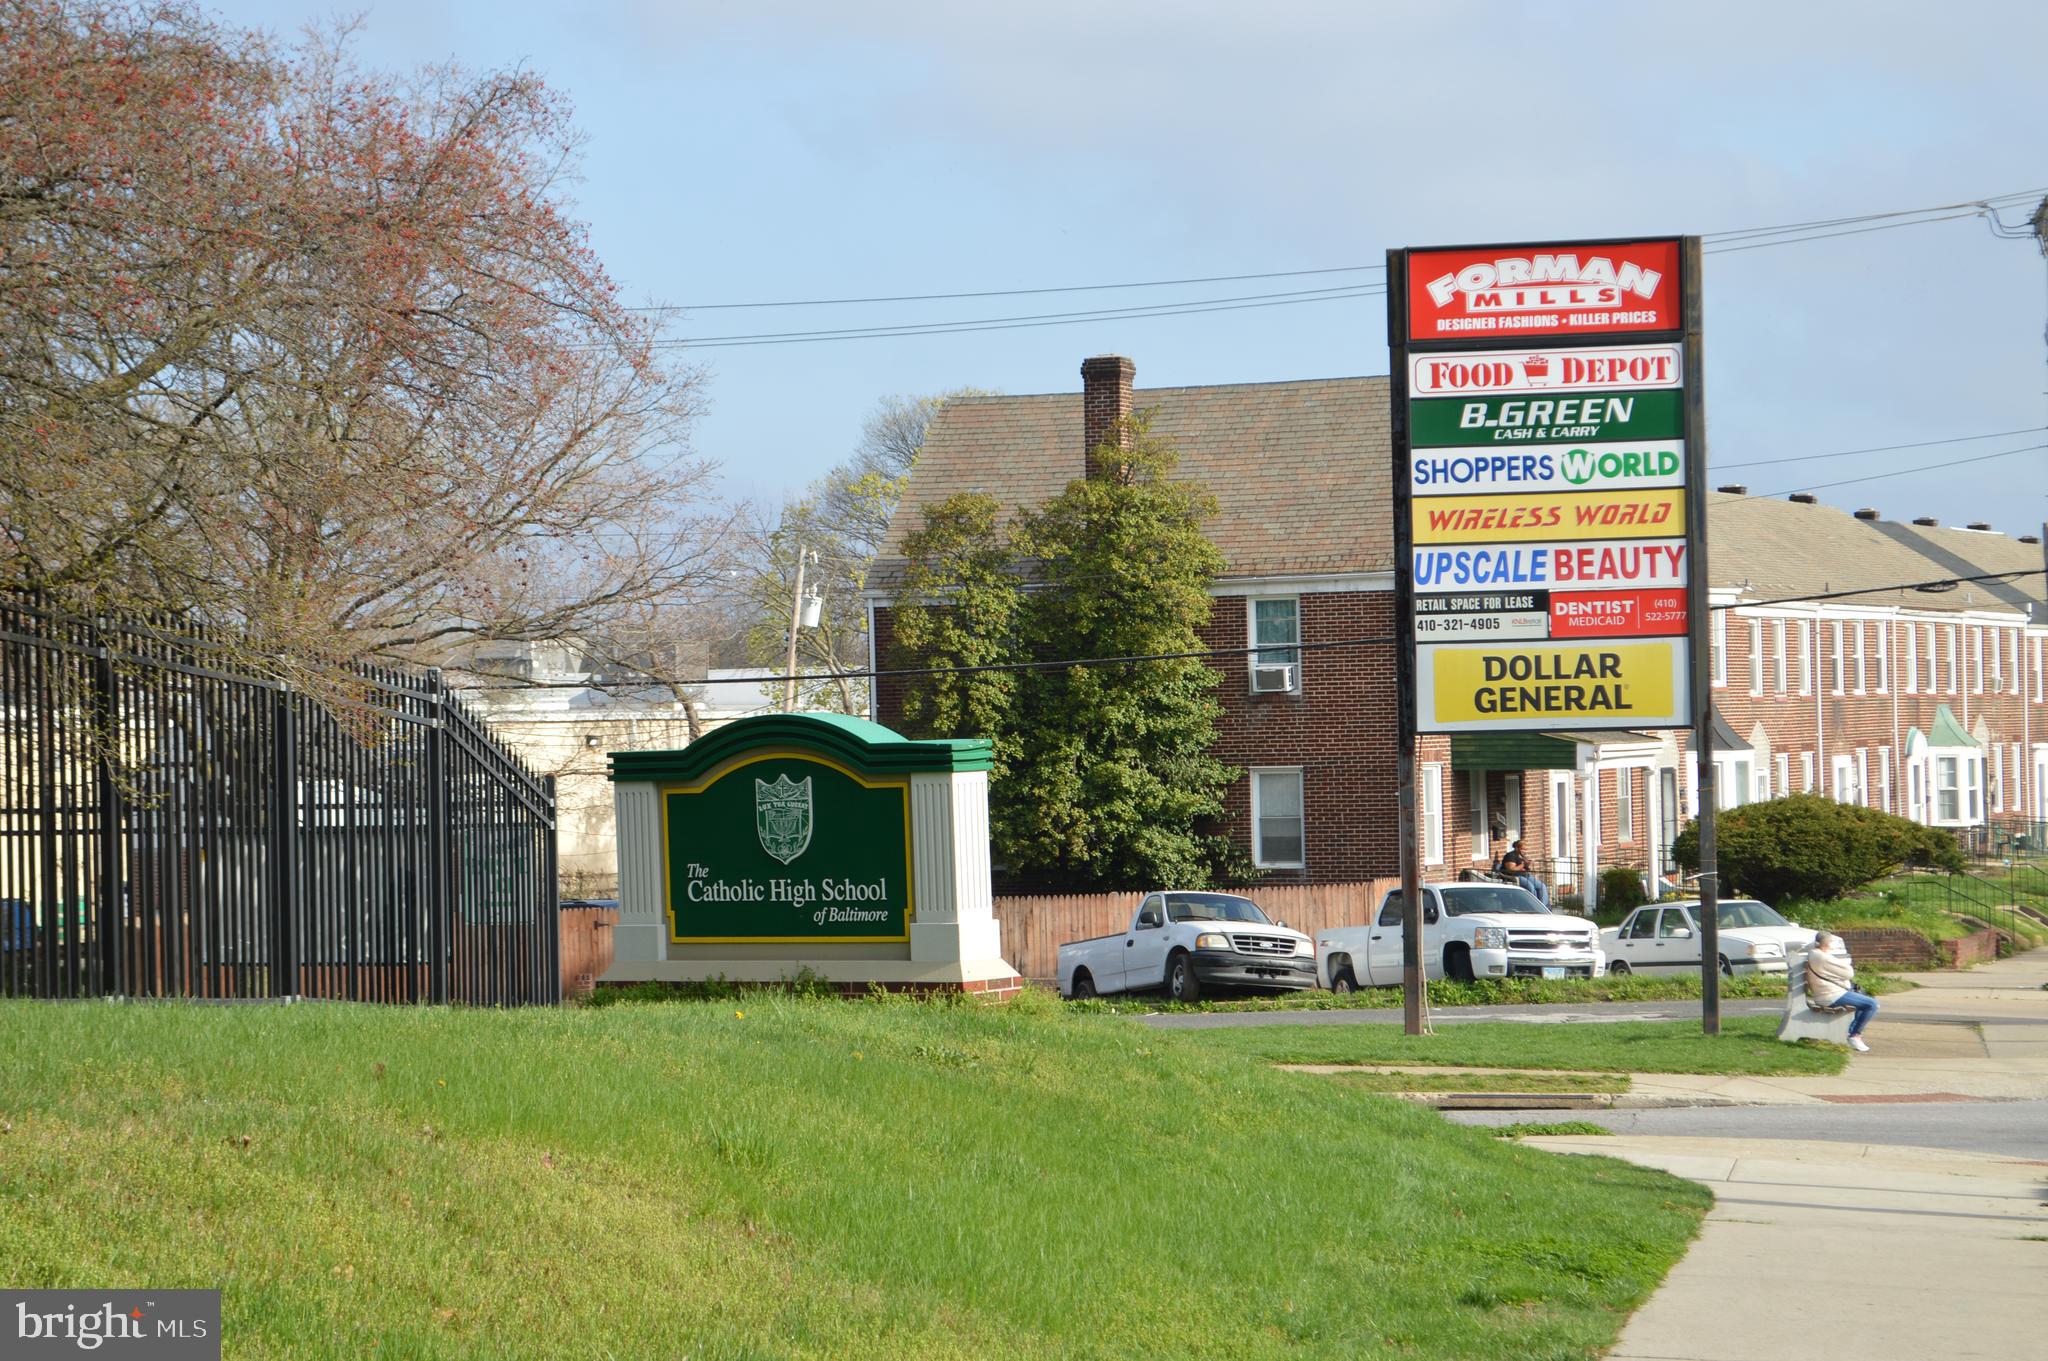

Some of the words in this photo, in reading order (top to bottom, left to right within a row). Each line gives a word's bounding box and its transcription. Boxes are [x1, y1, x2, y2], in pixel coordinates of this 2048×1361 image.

[1426, 254, 1662, 308] FORMAN
[1473, 289, 1617, 308] MILLS
[1437, 317, 1496, 331] DESIGNER
[1498, 314, 1559, 328] FASHIONS
[1569, 313, 1610, 326] KILLER
[1612, 310, 1657, 324] PRICES
[1430, 362, 1514, 389] FOOD
[1561, 356, 1671, 384] DEPOT
[1494, 428, 1531, 440] CASH
[1535, 427, 1548, 438] &
[1551, 425, 1600, 437] CARRY
[1414, 455, 1555, 485] SHOPPERS
[1560, 449, 1680, 485] WORLD
[1428, 506, 1562, 531] WIRELESS
[1575, 502, 1673, 525] WORLD
[1414, 549, 1548, 586] UPSCALE
[1554, 545, 1686, 581] BEAUTY
[1416, 599, 1448, 612] RETAIL
[1451, 598, 1480, 610] SPACE
[1484, 597, 1502, 609] FOR
[1505, 596, 1534, 609] LEASE
[1555, 599, 1635, 616] DENTIST
[1654, 598, 1677, 609] (410)
[1417, 618, 1500, 632] 410-321-4905
[1568, 615, 1626, 627] MEDICAID
[1645, 611, 1687, 622] 522-5777
[1483, 653, 1623, 681] DOLLAR
[1474, 684, 1633, 713] GENERAL
[687, 863, 710, 878] The
[687, 879, 765, 902] Catholic
[769, 879, 816, 907] High
[822, 878, 888, 901] School
[813, 908, 828, 925] of
[828, 907, 889, 922] Baltimore
